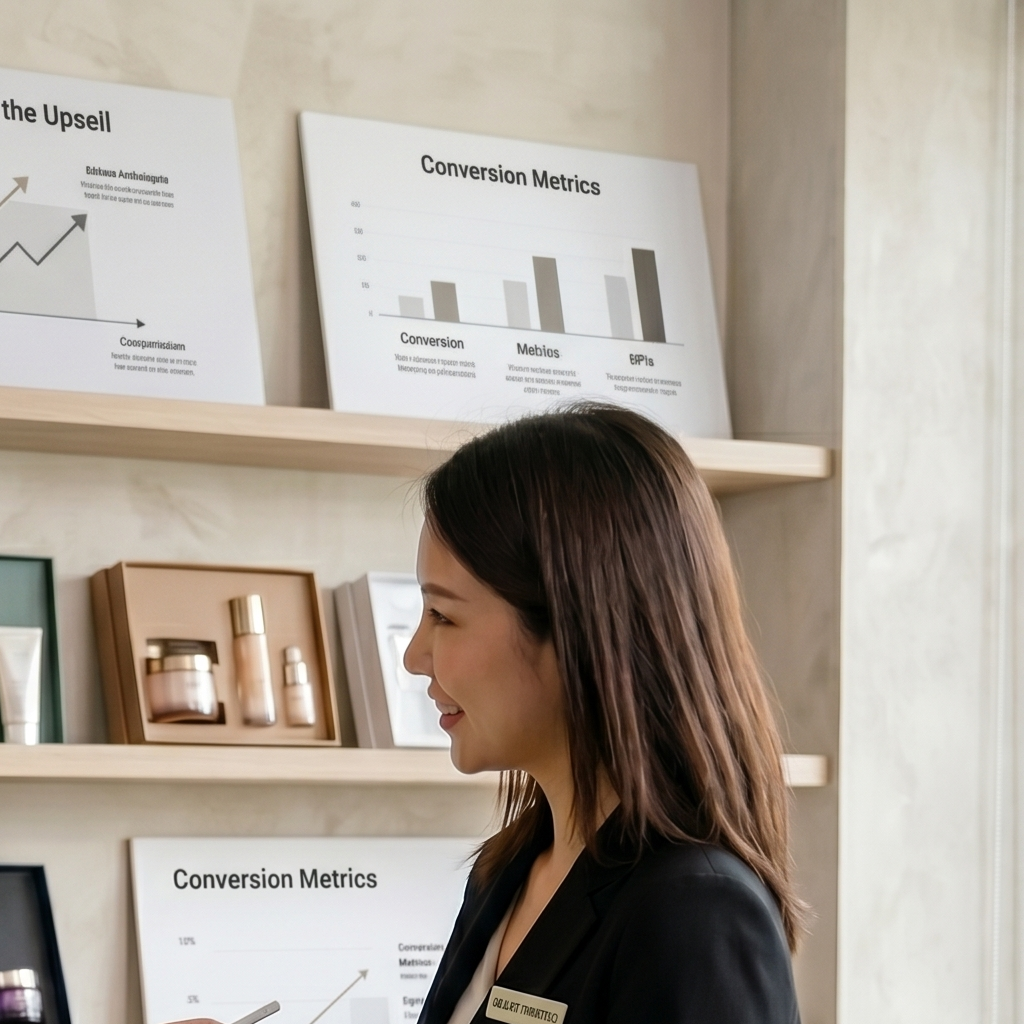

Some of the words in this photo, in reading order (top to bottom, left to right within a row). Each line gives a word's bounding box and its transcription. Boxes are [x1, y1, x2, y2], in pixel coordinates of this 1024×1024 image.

[1, 98, 37, 123] the
[420, 154, 528, 187] Conversion
[532, 168, 602, 196] Metrics
[400, 331, 465, 350] Conversion
[173, 867, 294, 890] Conversion
[299, 867, 378, 889] Metrics
